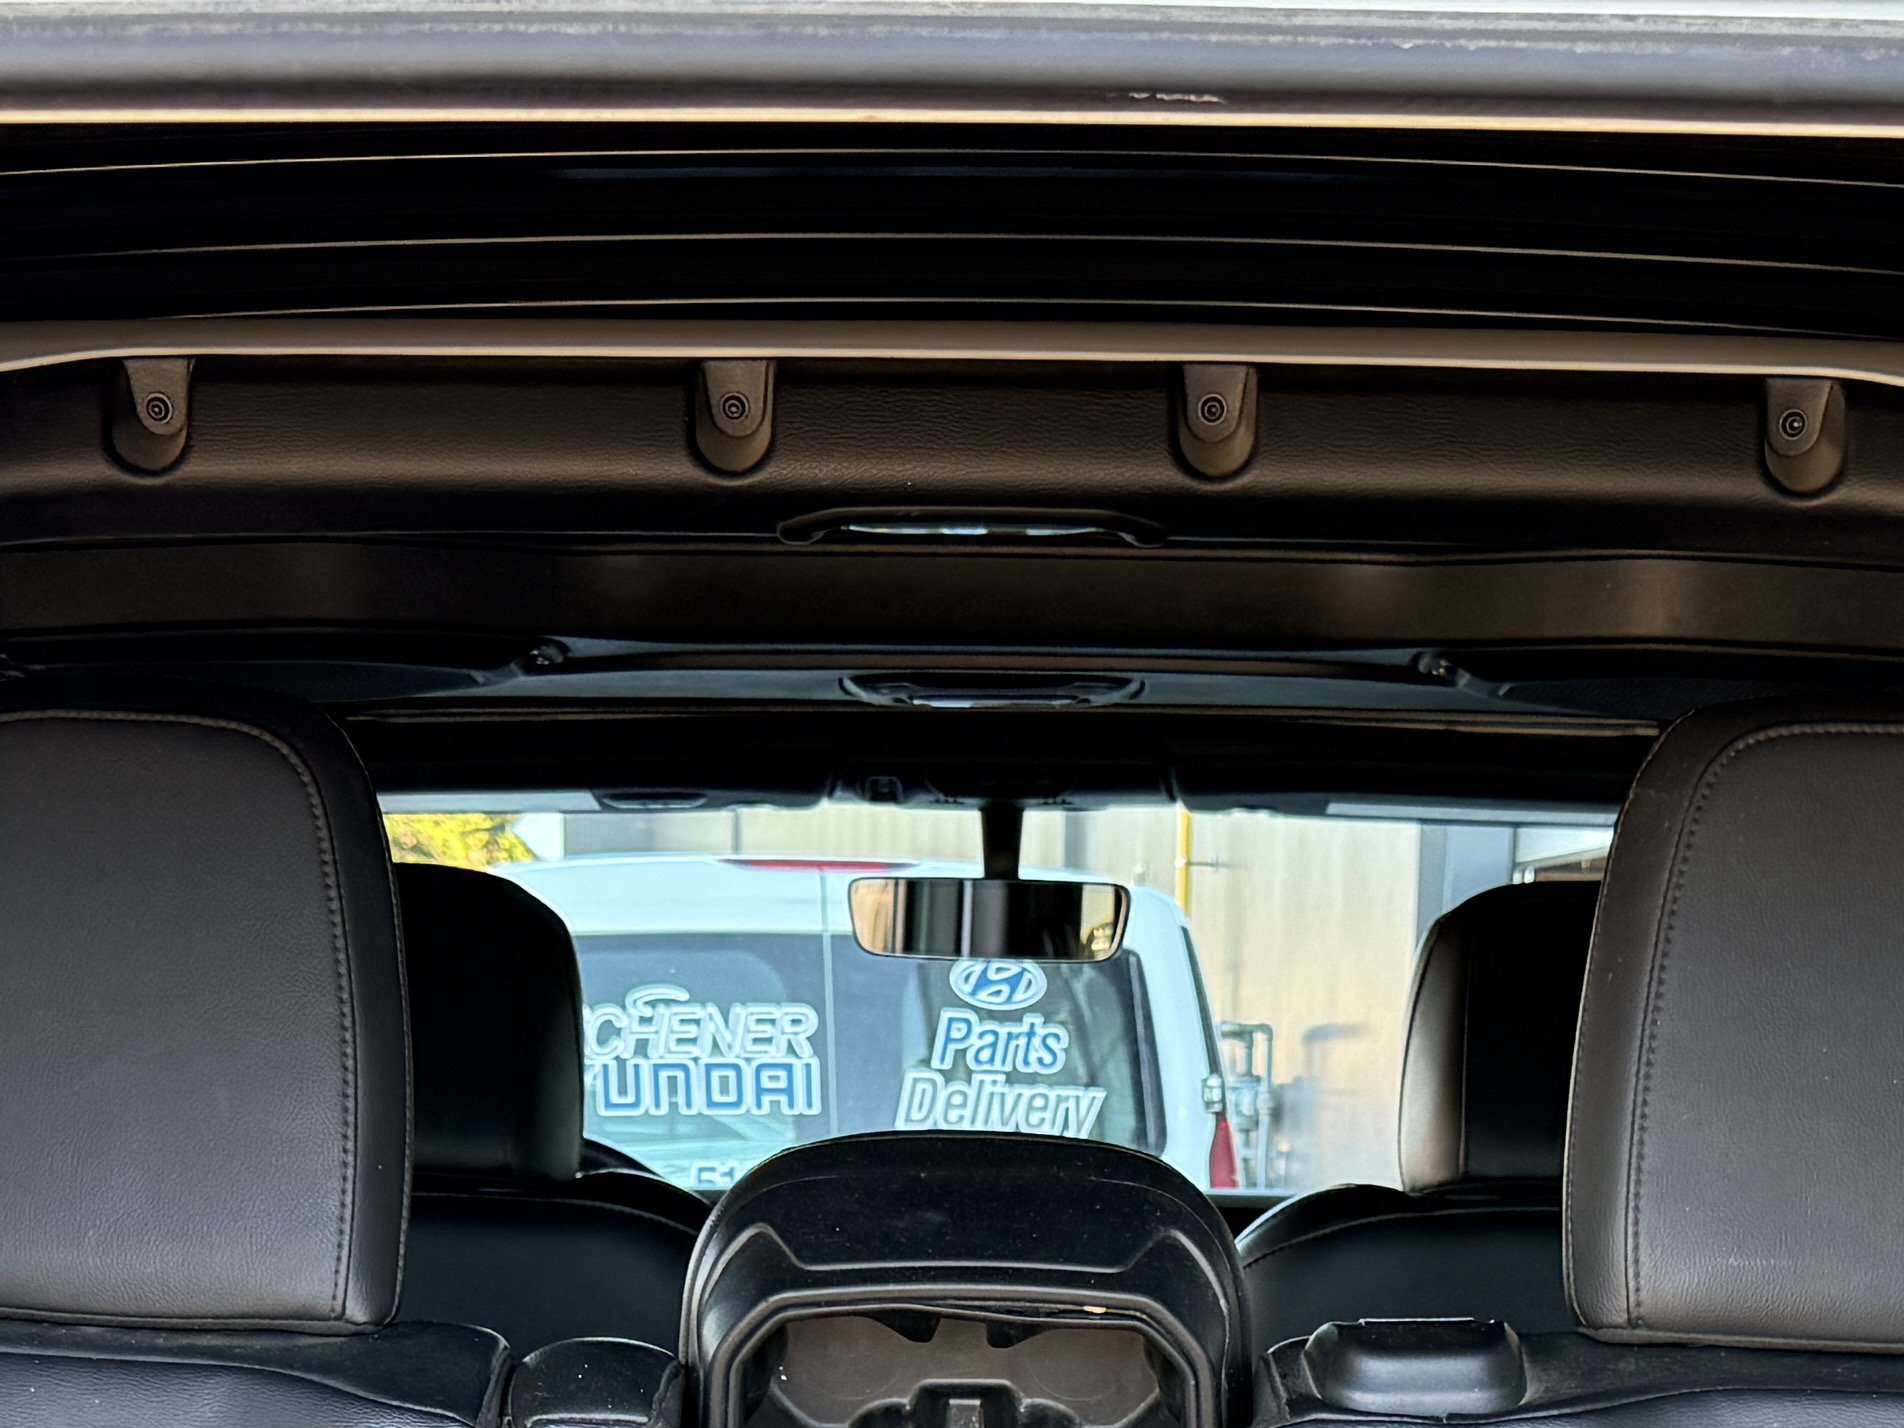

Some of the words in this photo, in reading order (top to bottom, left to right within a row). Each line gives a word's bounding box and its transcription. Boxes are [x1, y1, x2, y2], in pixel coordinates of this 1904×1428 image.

[584, 983, 819, 1059] CHENER
[931, 1008, 1069, 1074] Parts
[895, 1068, 1107, 1139] Delivery
